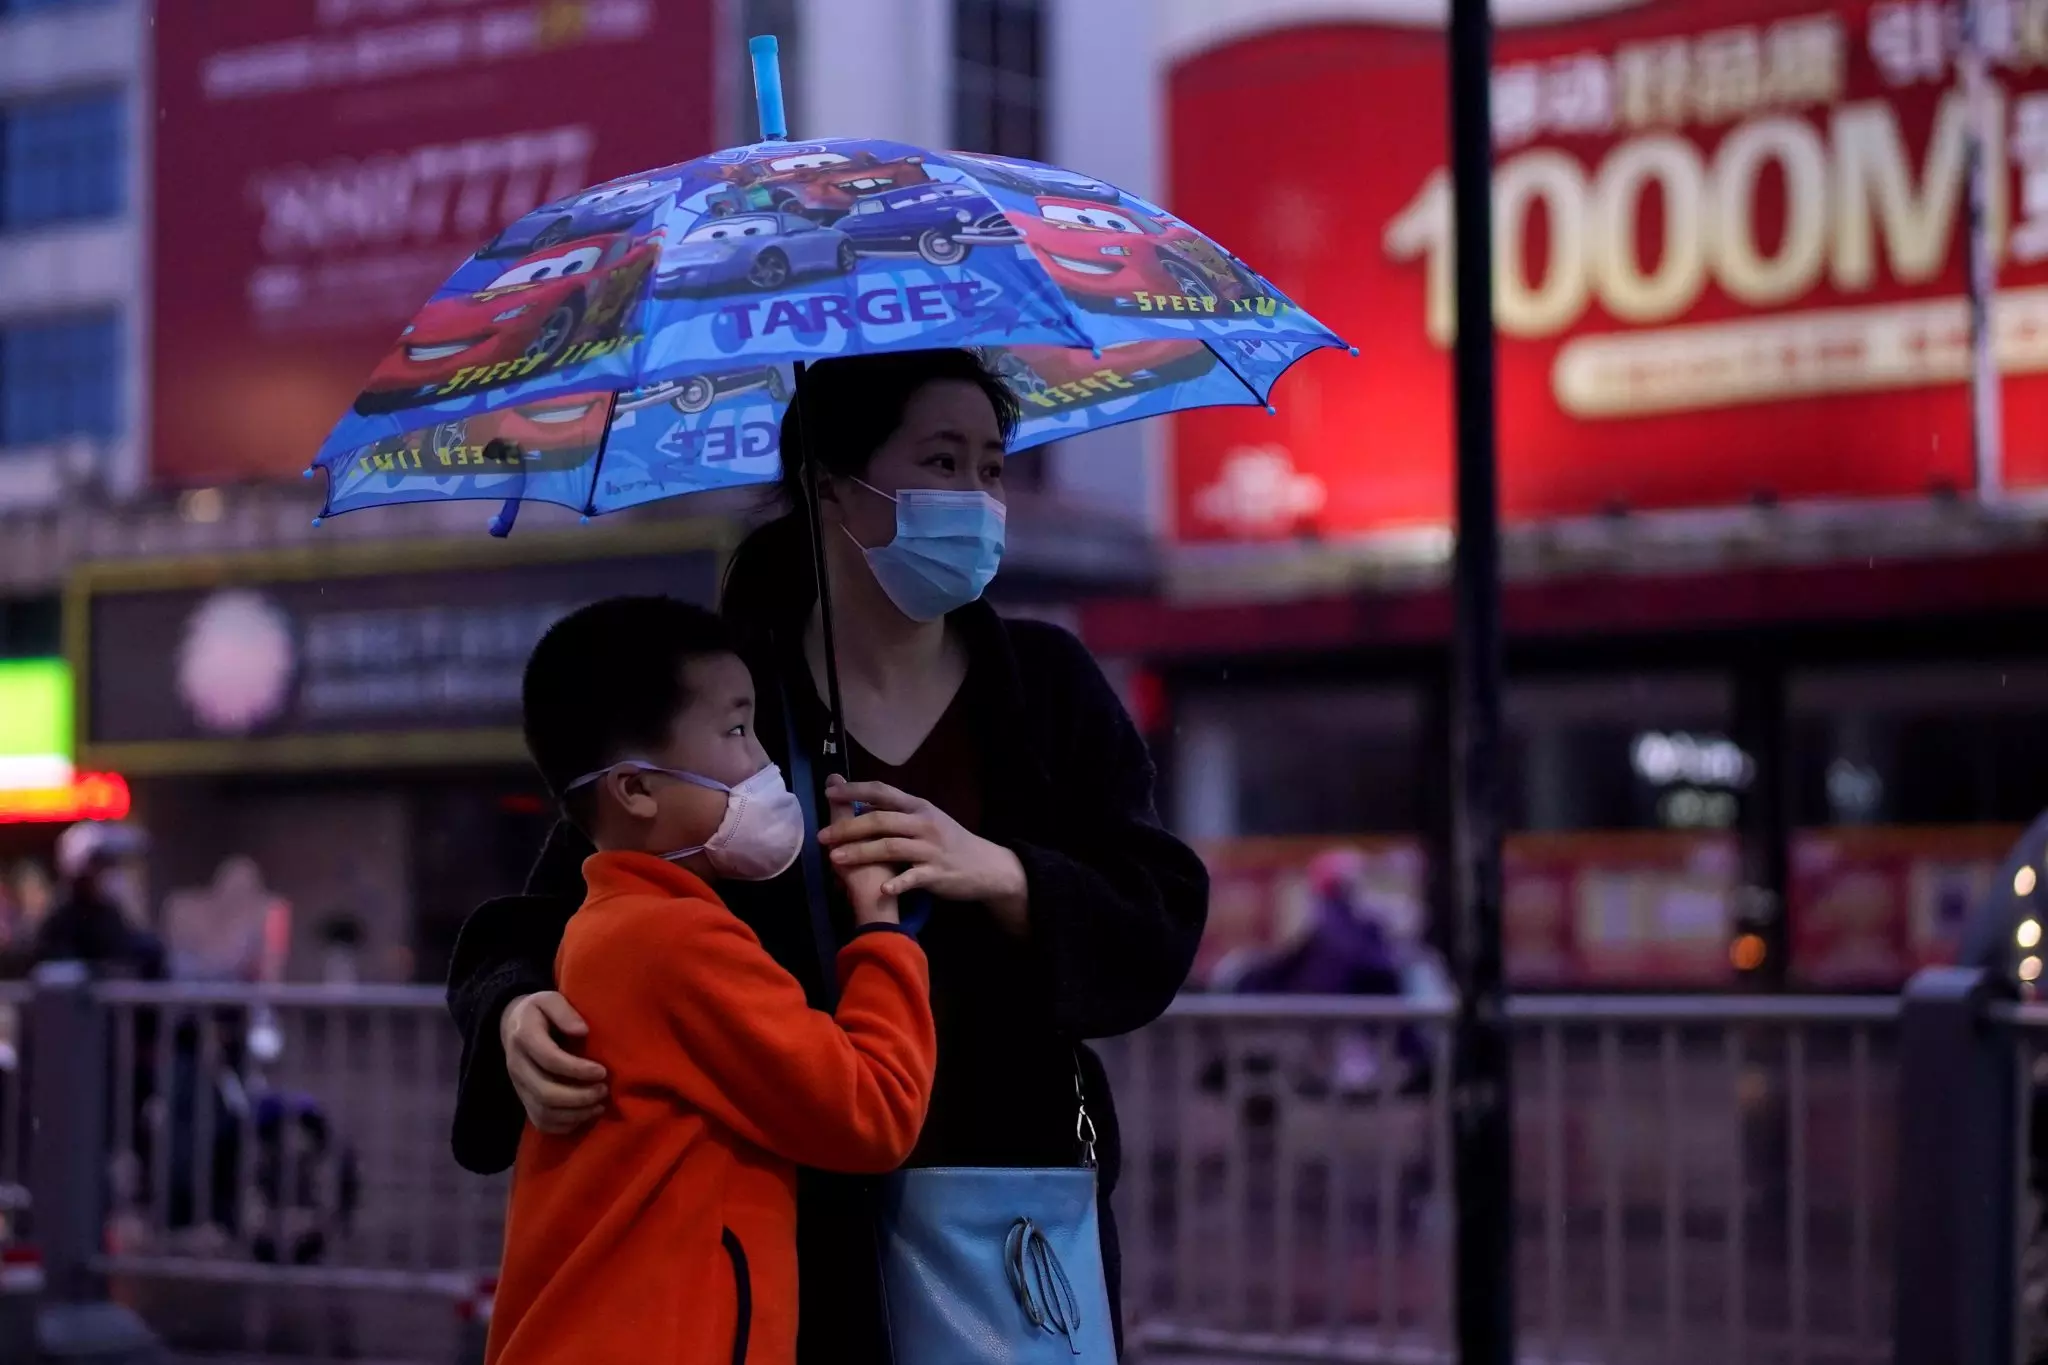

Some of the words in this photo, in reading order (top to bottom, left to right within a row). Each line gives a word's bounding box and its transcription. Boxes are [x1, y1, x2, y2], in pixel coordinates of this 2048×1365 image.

[721, 280, 981, 340] TARGET
[1132, 291, 1216, 314] SPEED
[437, 352, 548, 396] SPEED
